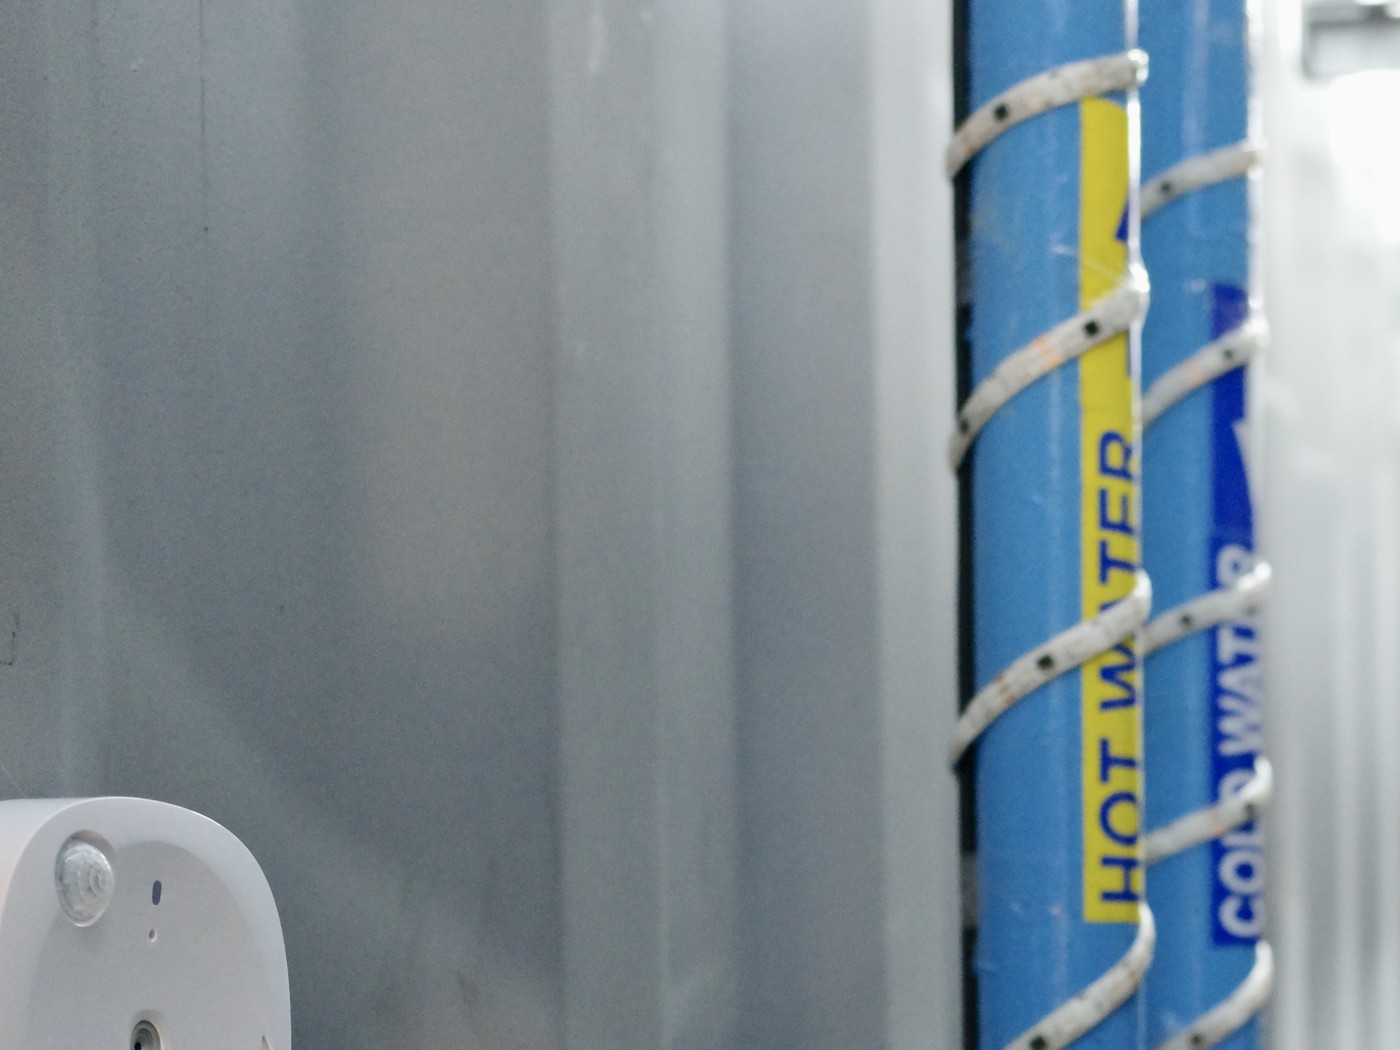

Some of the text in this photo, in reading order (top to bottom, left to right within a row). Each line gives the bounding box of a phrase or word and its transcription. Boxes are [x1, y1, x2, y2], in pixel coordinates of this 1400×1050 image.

[1098, 430, 1139, 903] HOT WTER
[1216, 543, 1263, 757] WATR
